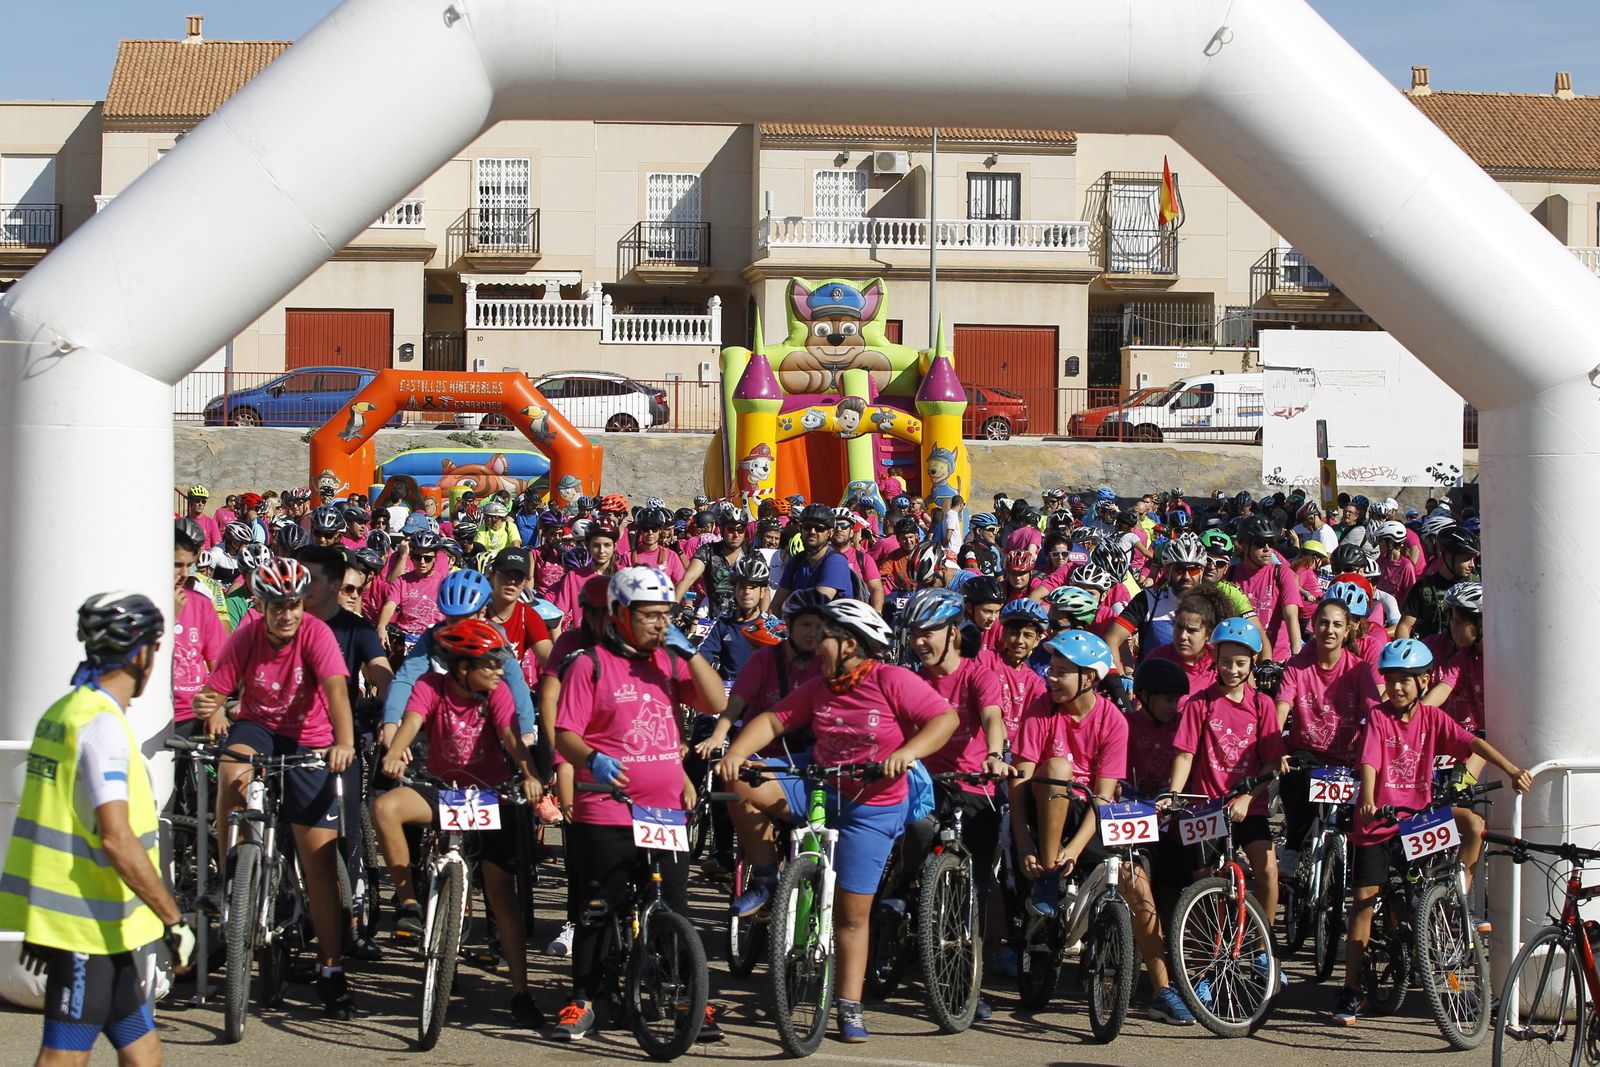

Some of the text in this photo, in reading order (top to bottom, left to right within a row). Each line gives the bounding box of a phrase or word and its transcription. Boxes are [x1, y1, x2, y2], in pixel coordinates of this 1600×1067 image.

[399, 379, 447, 393] CASTILLOS
[636, 754, 648, 762] DE
[648, 753, 658, 762] LA
[1314, 783, 1355, 801] 205
[640, 825, 679, 847] 241
[1107, 820, 1151, 842] 392
[1184, 816, 1218, 841] 397
[1408, 826, 1451, 856] 399
